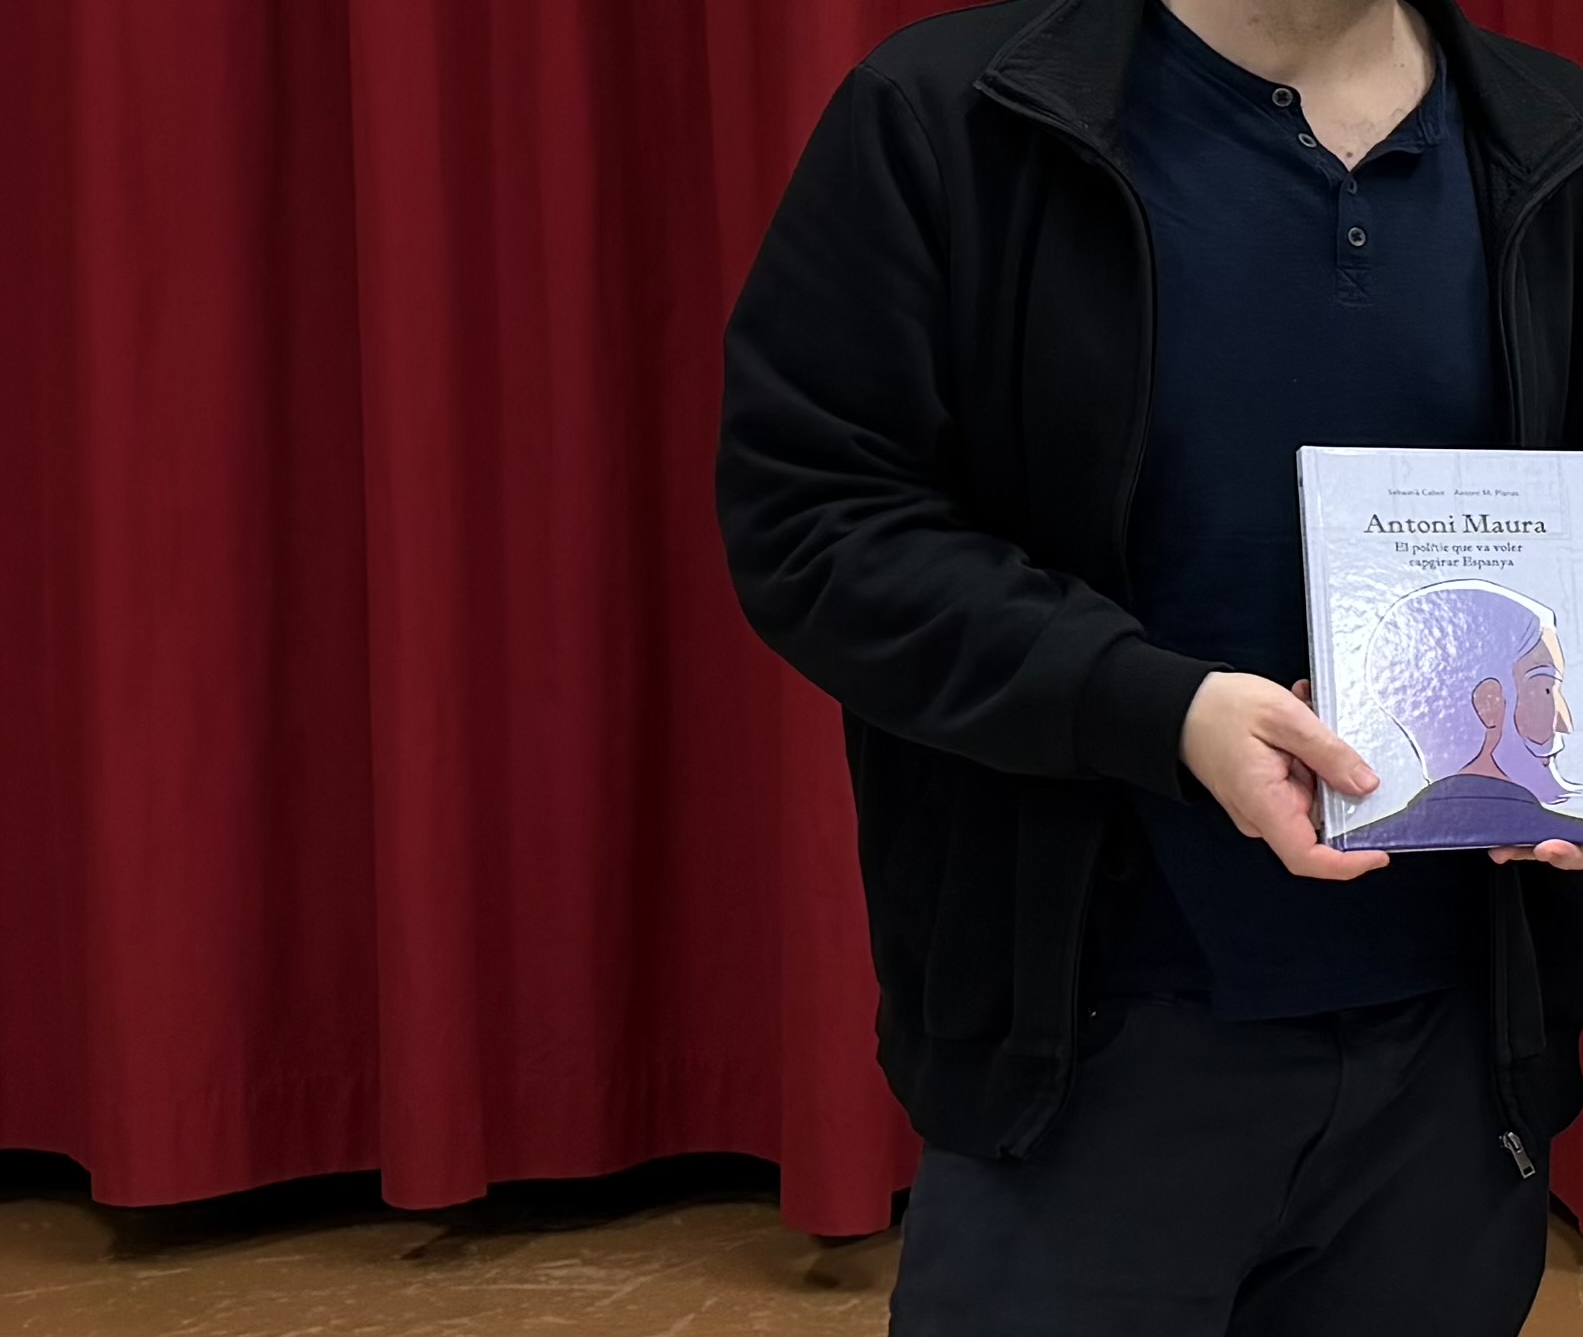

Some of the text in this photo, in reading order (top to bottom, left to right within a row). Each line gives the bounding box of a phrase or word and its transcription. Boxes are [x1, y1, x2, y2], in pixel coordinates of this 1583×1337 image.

[1363, 513, 1547, 533] Antoni Maura
[1395, 542, 1408, 552] El
[1452, 544, 1472, 555] que
[1477, 544, 1490, 552] va
[1493, 542, 1523, 552] voler
[1409, 556, 1514, 570] capgirar Espanya
